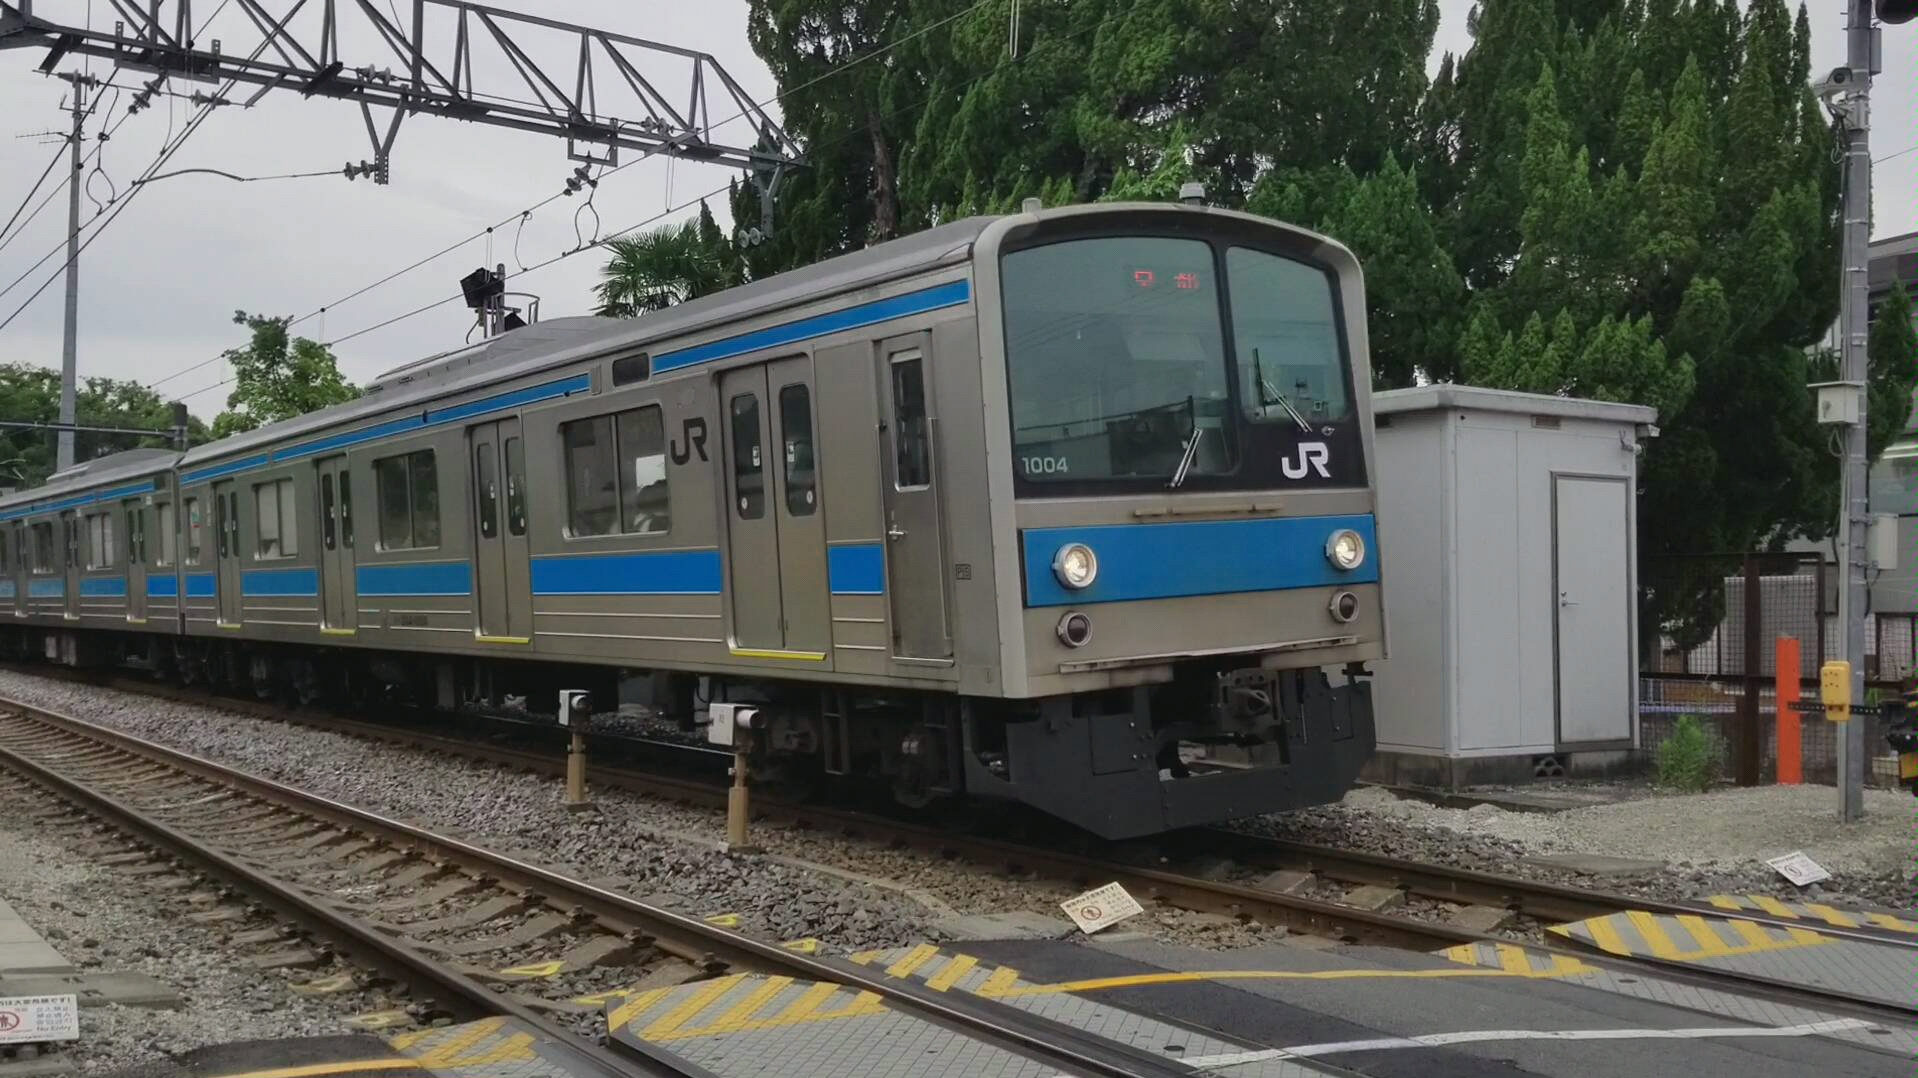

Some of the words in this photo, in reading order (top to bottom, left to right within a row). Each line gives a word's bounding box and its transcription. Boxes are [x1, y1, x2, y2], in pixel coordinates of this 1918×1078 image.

[670, 417, 709, 466] JR
[1281, 441, 1331, 480] JR
[1021, 456, 1069, 474] 1004
